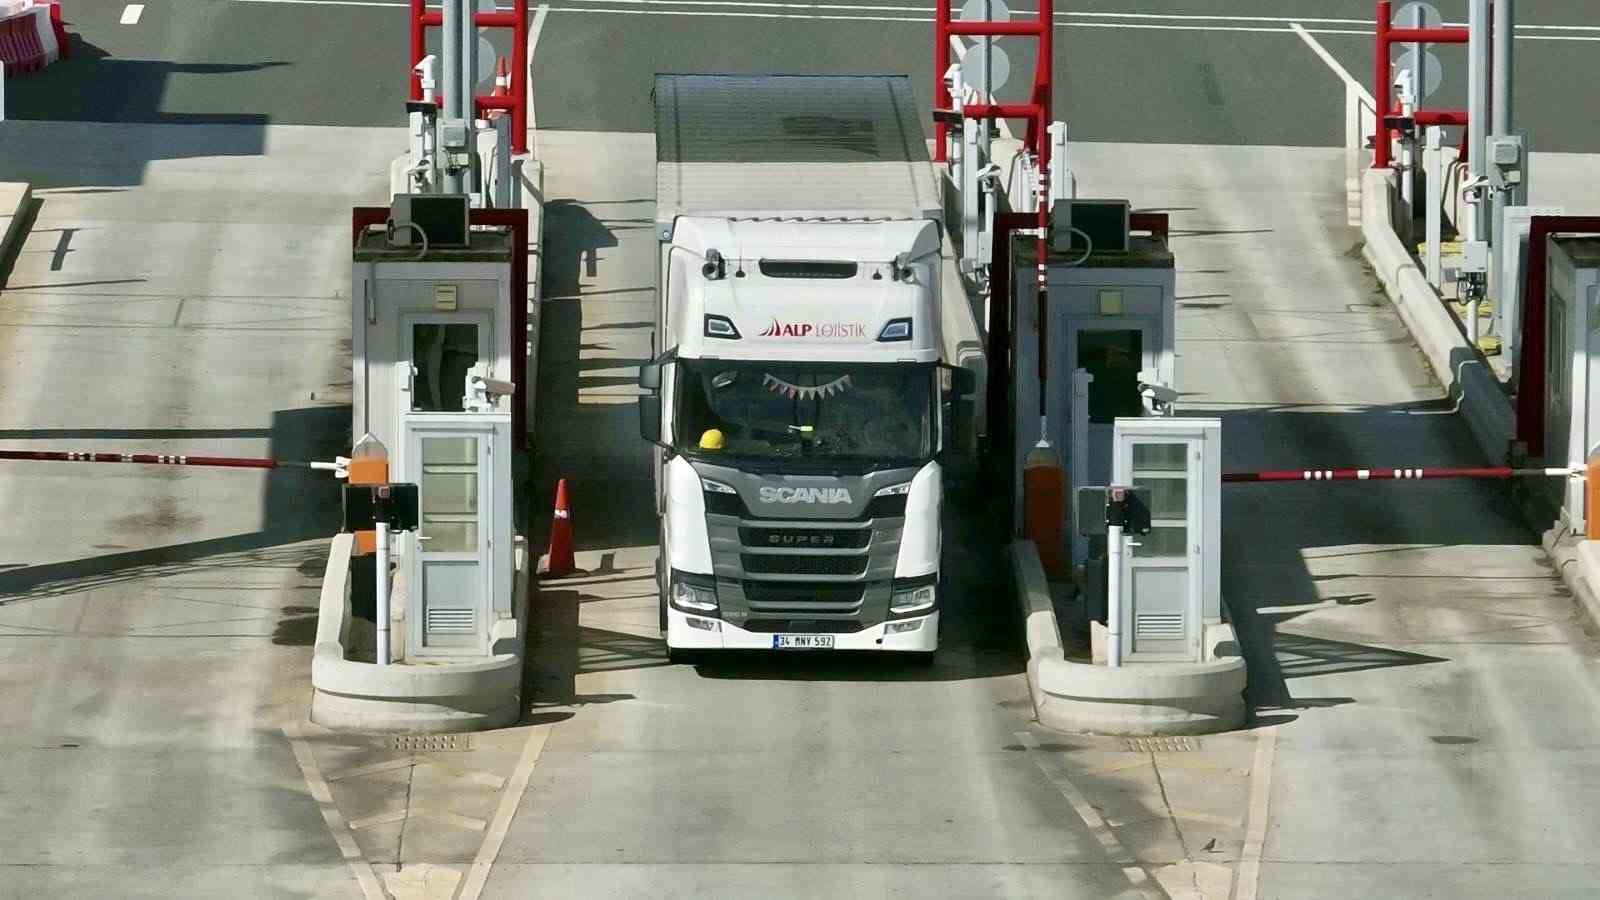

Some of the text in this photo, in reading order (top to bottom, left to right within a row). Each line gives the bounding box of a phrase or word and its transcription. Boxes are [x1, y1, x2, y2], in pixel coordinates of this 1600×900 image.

[783, 323, 812, 337] ALP
[760, 486, 852, 504] SCANIA
[768, 535, 834, 544] SUPER
[780, 636, 790, 646] 34
[815, 636, 831, 646] 592
